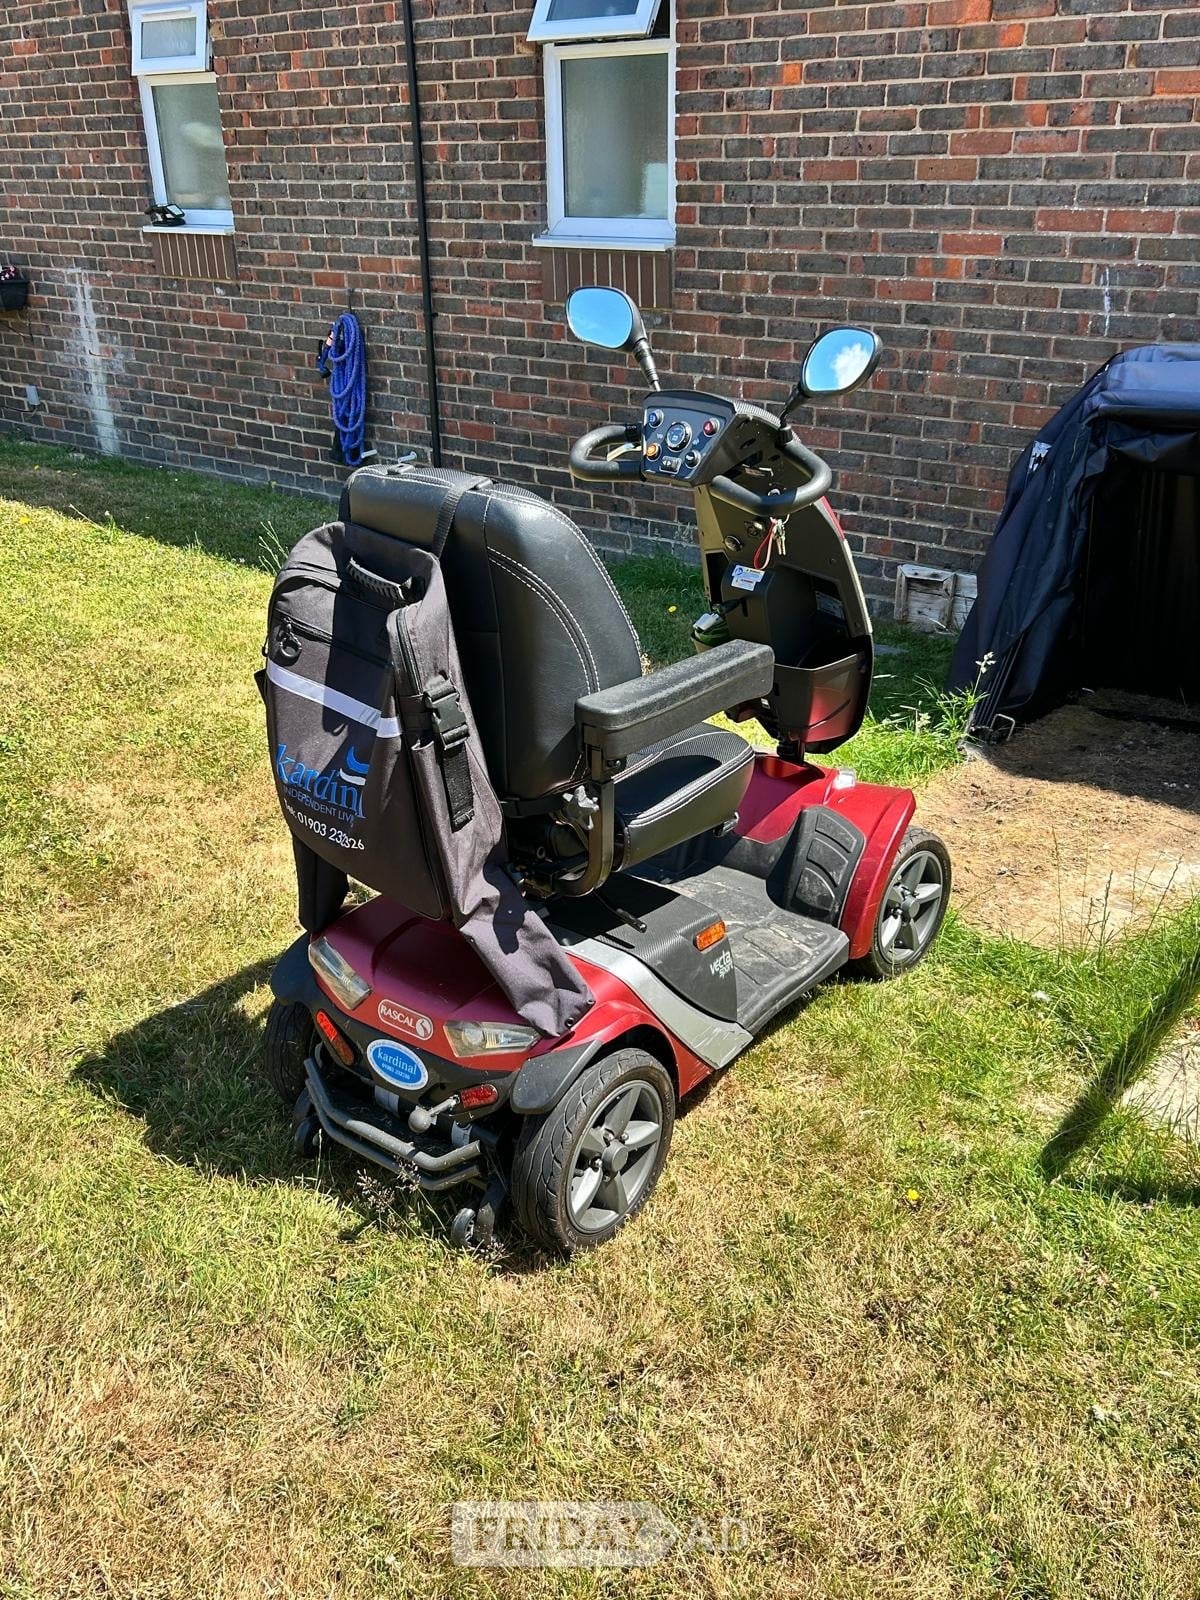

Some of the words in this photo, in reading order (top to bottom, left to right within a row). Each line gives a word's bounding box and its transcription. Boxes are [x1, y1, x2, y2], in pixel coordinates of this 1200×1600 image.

[297, 811, 327, 837] 01903
[380, 1004, 416, 1029] RASCAL
[377, 1047, 418, 1075] kardinal
